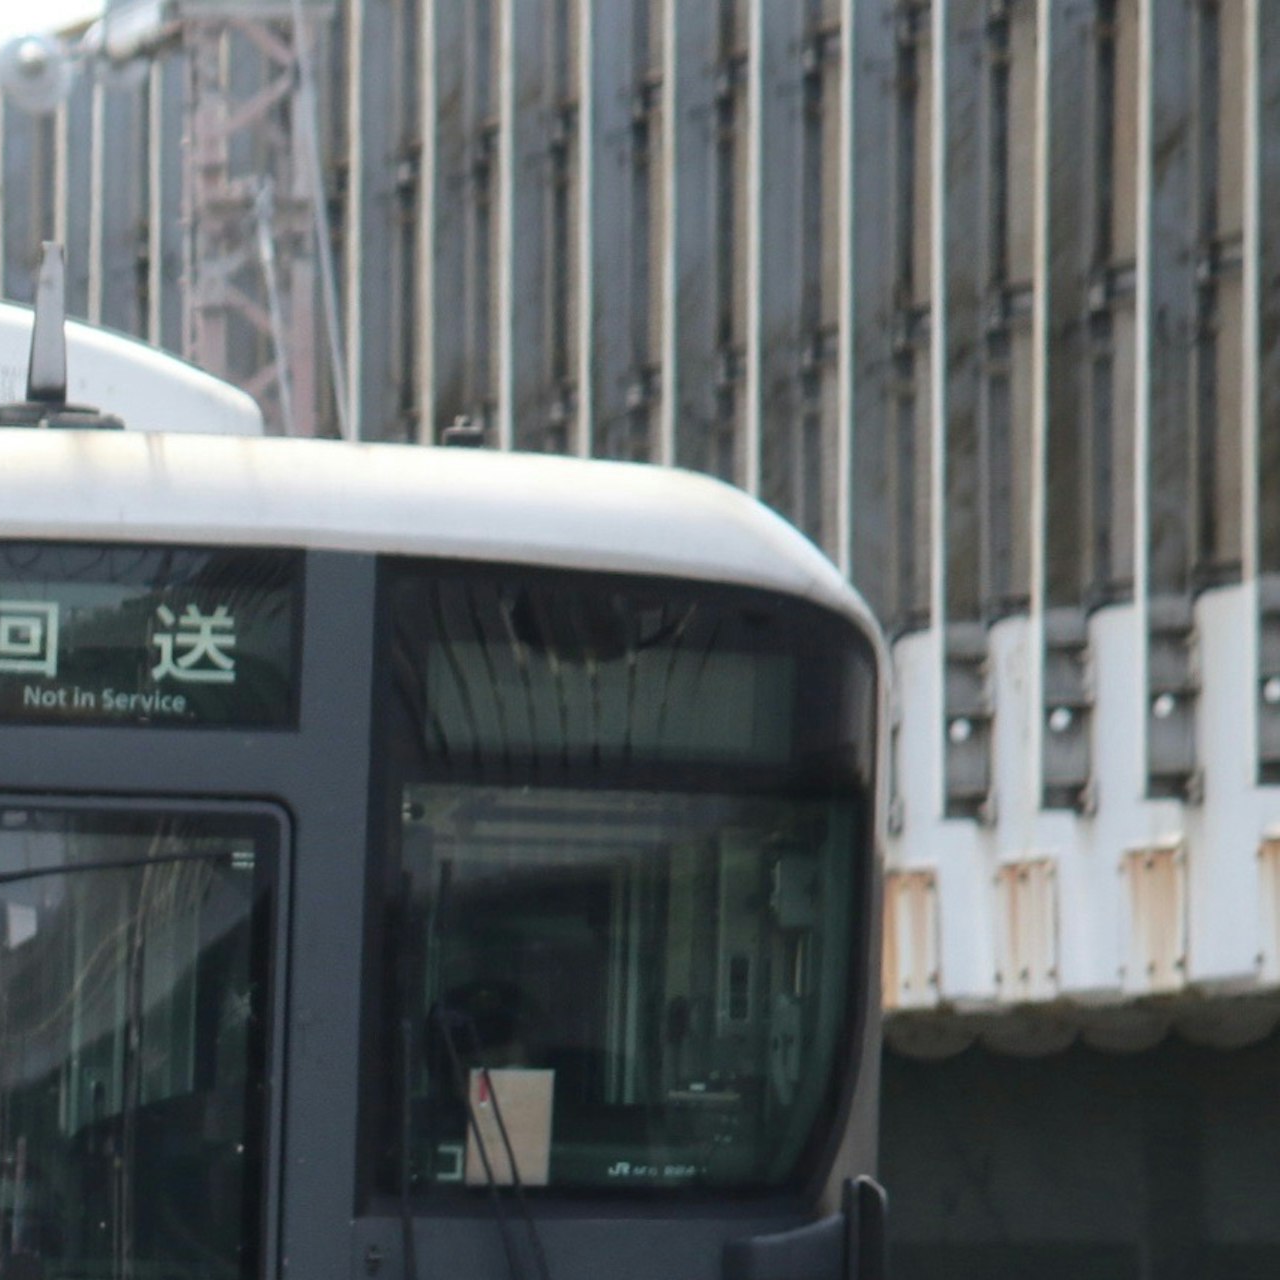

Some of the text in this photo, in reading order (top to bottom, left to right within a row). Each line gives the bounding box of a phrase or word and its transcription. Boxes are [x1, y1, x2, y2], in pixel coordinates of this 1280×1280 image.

[22, 685, 187, 713] Not in Service
